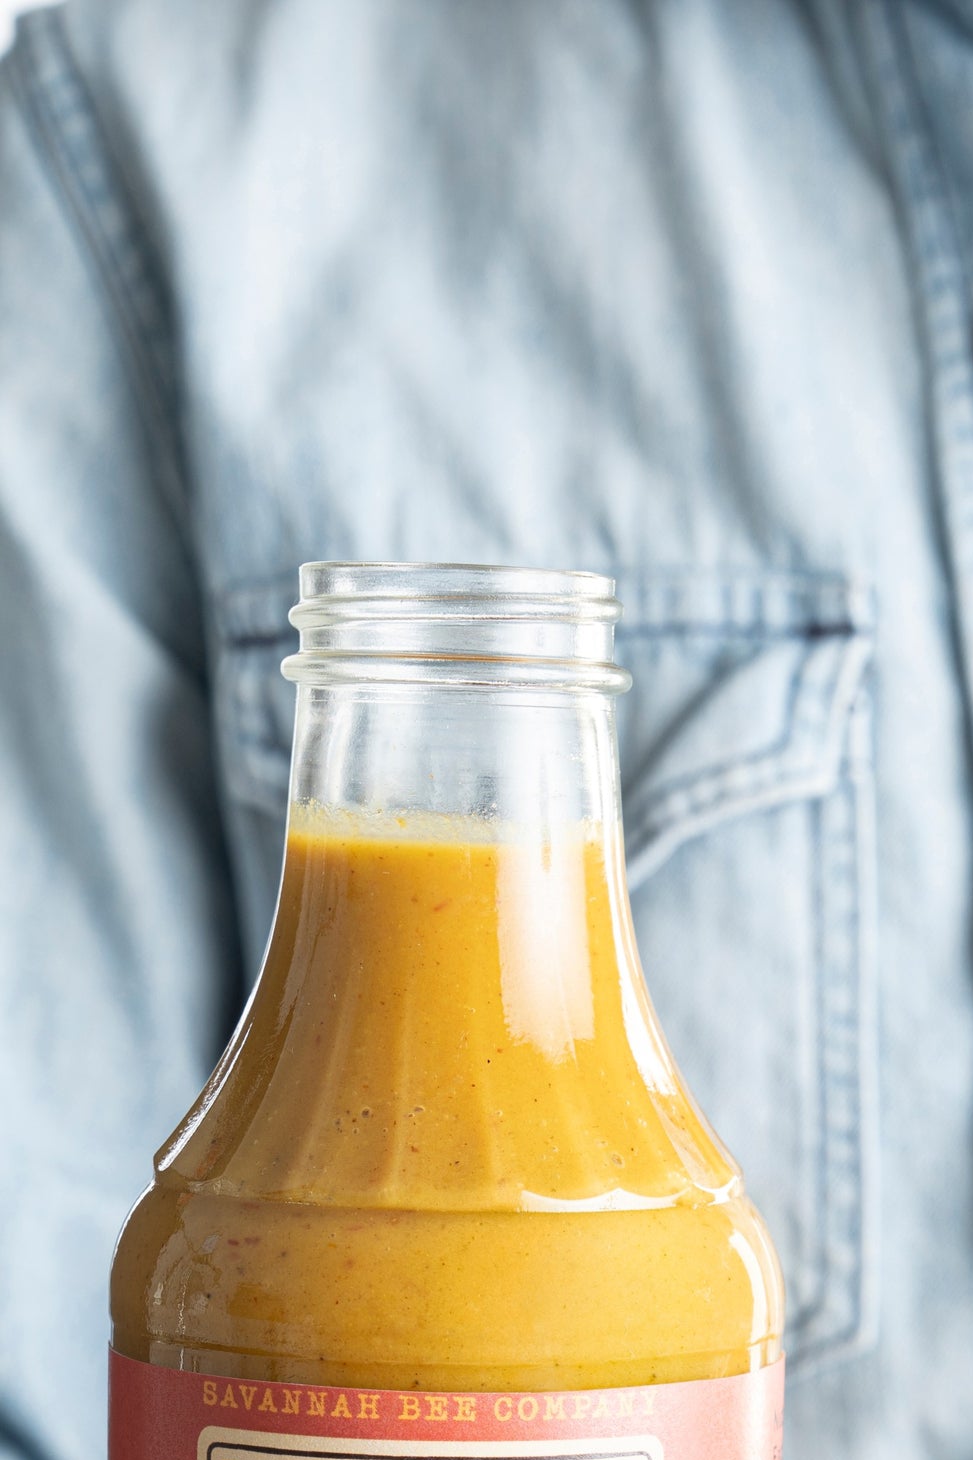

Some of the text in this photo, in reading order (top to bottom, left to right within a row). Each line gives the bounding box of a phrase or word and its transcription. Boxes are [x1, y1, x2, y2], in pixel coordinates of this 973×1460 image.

[203, 1381, 659, 1422] SAVANNAH BEE COMPANY
